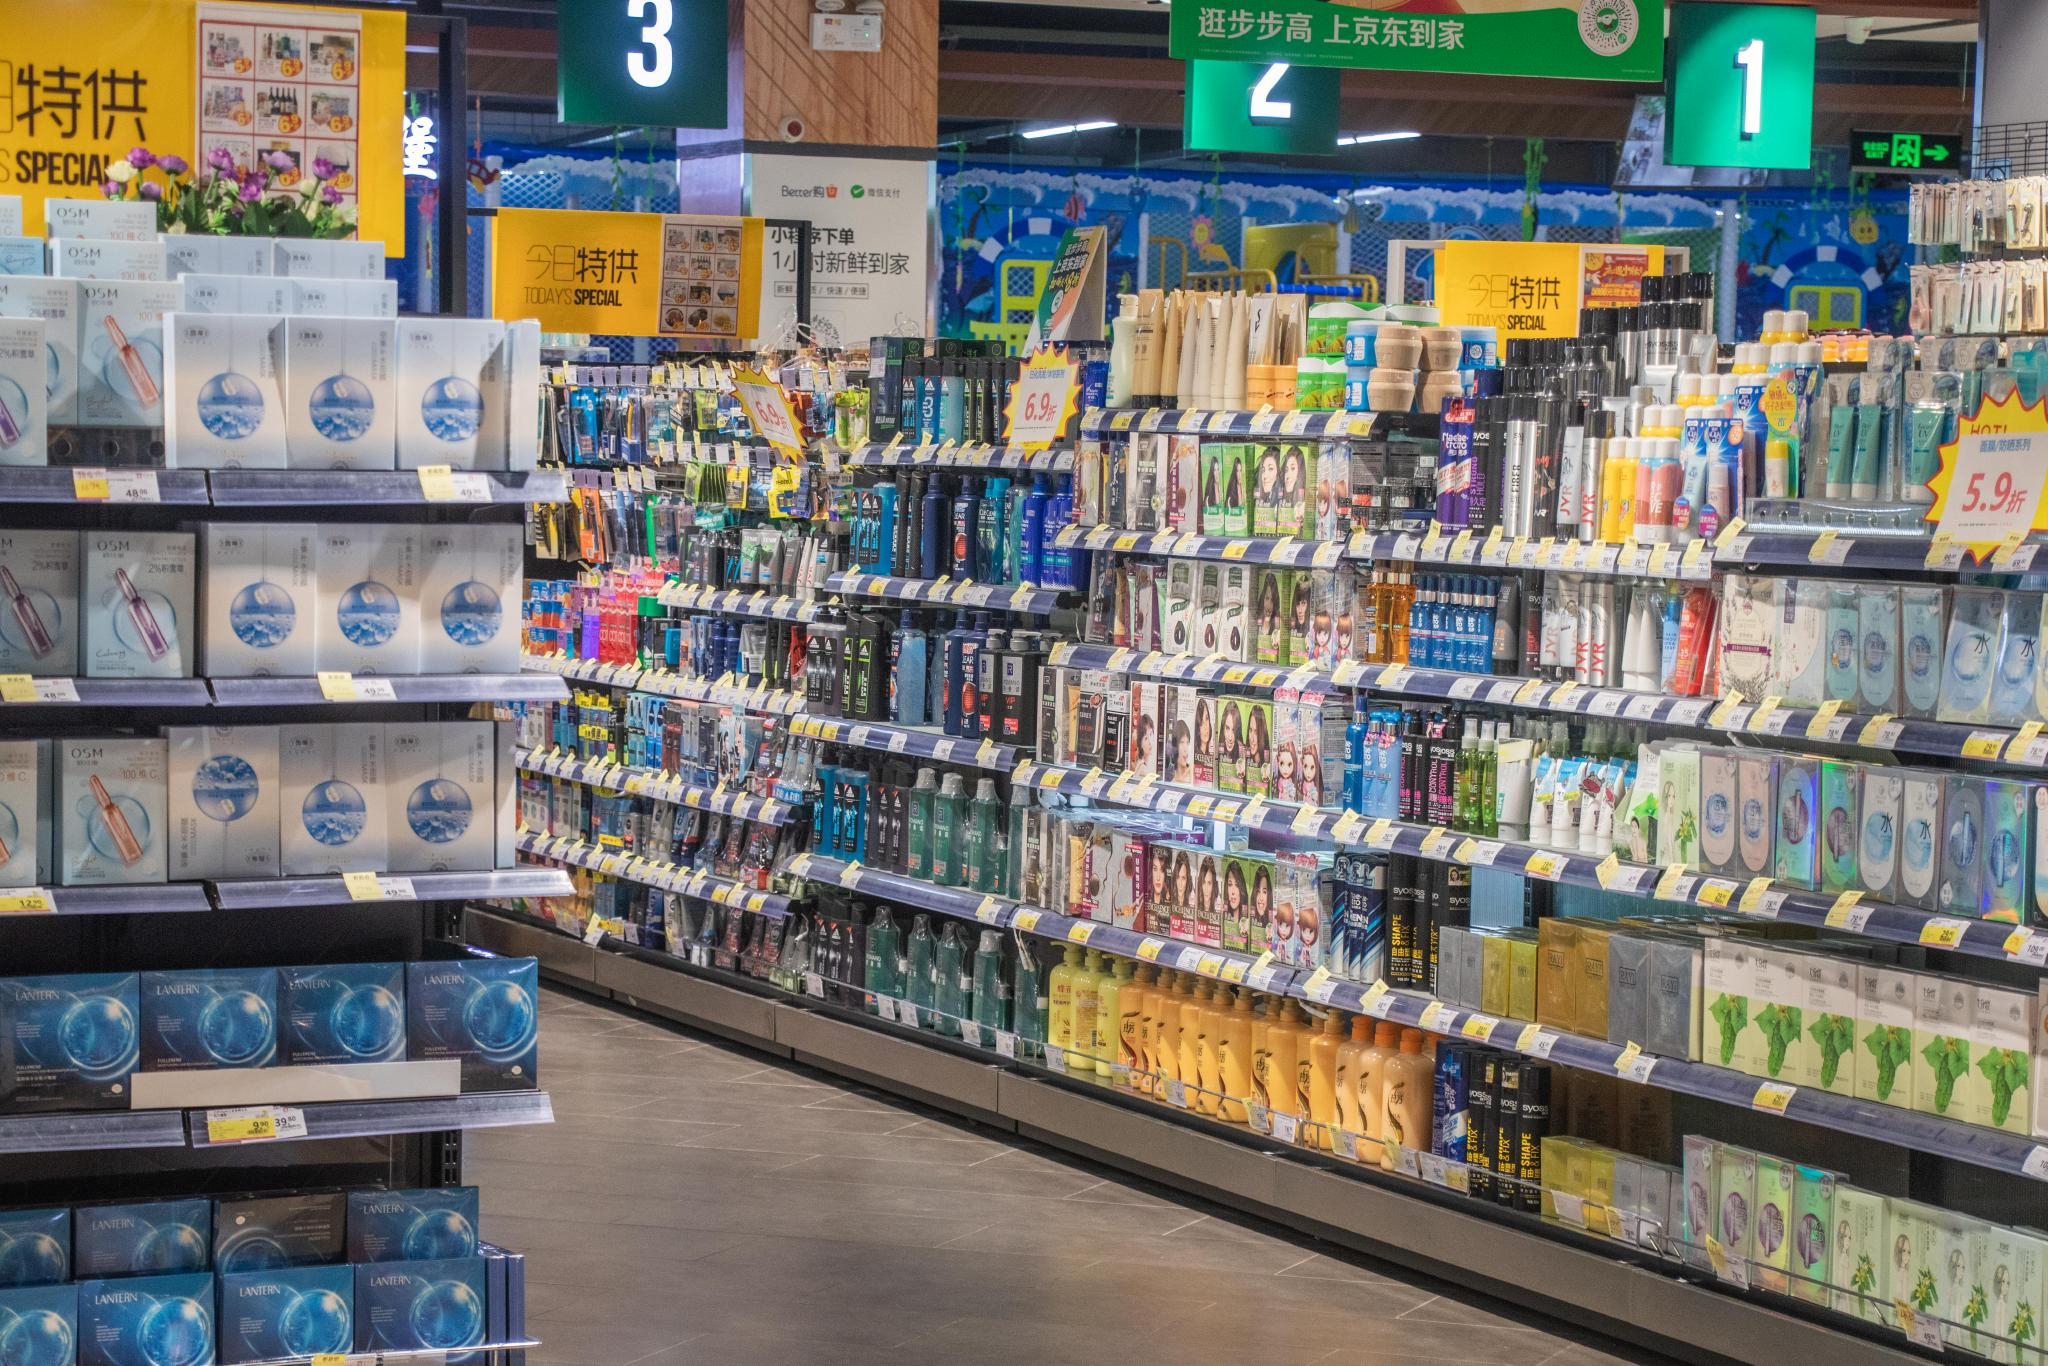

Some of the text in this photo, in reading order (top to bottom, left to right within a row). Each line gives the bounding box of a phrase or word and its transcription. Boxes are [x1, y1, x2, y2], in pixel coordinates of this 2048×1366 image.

[1198, 7, 1465, 50] 逛步步高 上京东到家
[626, 0, 673, 88] 3
[1736, 38, 1764, 135] 1
[0, 61, 148, 142] 特供
[57, 207, 89, 219] OSM
[68, 247, 101, 258] OSM
[773, 250, 910, 276] 1小时新鲜到家
[525, 243, 639, 285] 今日特供
[85, 288, 118, 299] OSM
[524, 285, 623, 307] TODAY'S SPECIAL
[1467, 274, 1560, 310] 今日特供
[1507, 314, 1546, 331] SPECIAL
[1961, 471, 2028, 514] 5.9折
[1581, 492, 1597, 528] JYR
[96, 540, 130, 551] OSM
[1974, 633, 1990, 654] 水
[2020, 636, 2036, 657] 水
[1576, 641, 1589, 675] JYR
[1591, 642, 1606, 677] JYR
[71, 747, 103, 759] OSM
[1438, 761, 1448, 796] CONTROL
[1880, 811, 1893, 833] 水
[1919, 820, 1931, 840] 水
[1391, 913, 1402, 946] SHAPE
[156, 983, 200, 996] LANTERN
[424, 974, 465, 985] LANTERN
[15, 991, 60, 1001] LANTERN
[252, 1120, 269, 1130] 9.90
[1521, 1132, 1531, 1167] SHAPE
[363, 1203, 405, 1215] LANTERN
[92, 1216, 135, 1230] LANTERN
[239, 1284, 281, 1297] LANTERN
[370, 1274, 412, 1287] LANTERN
[95, 1291, 138, 1305] LANTERN
